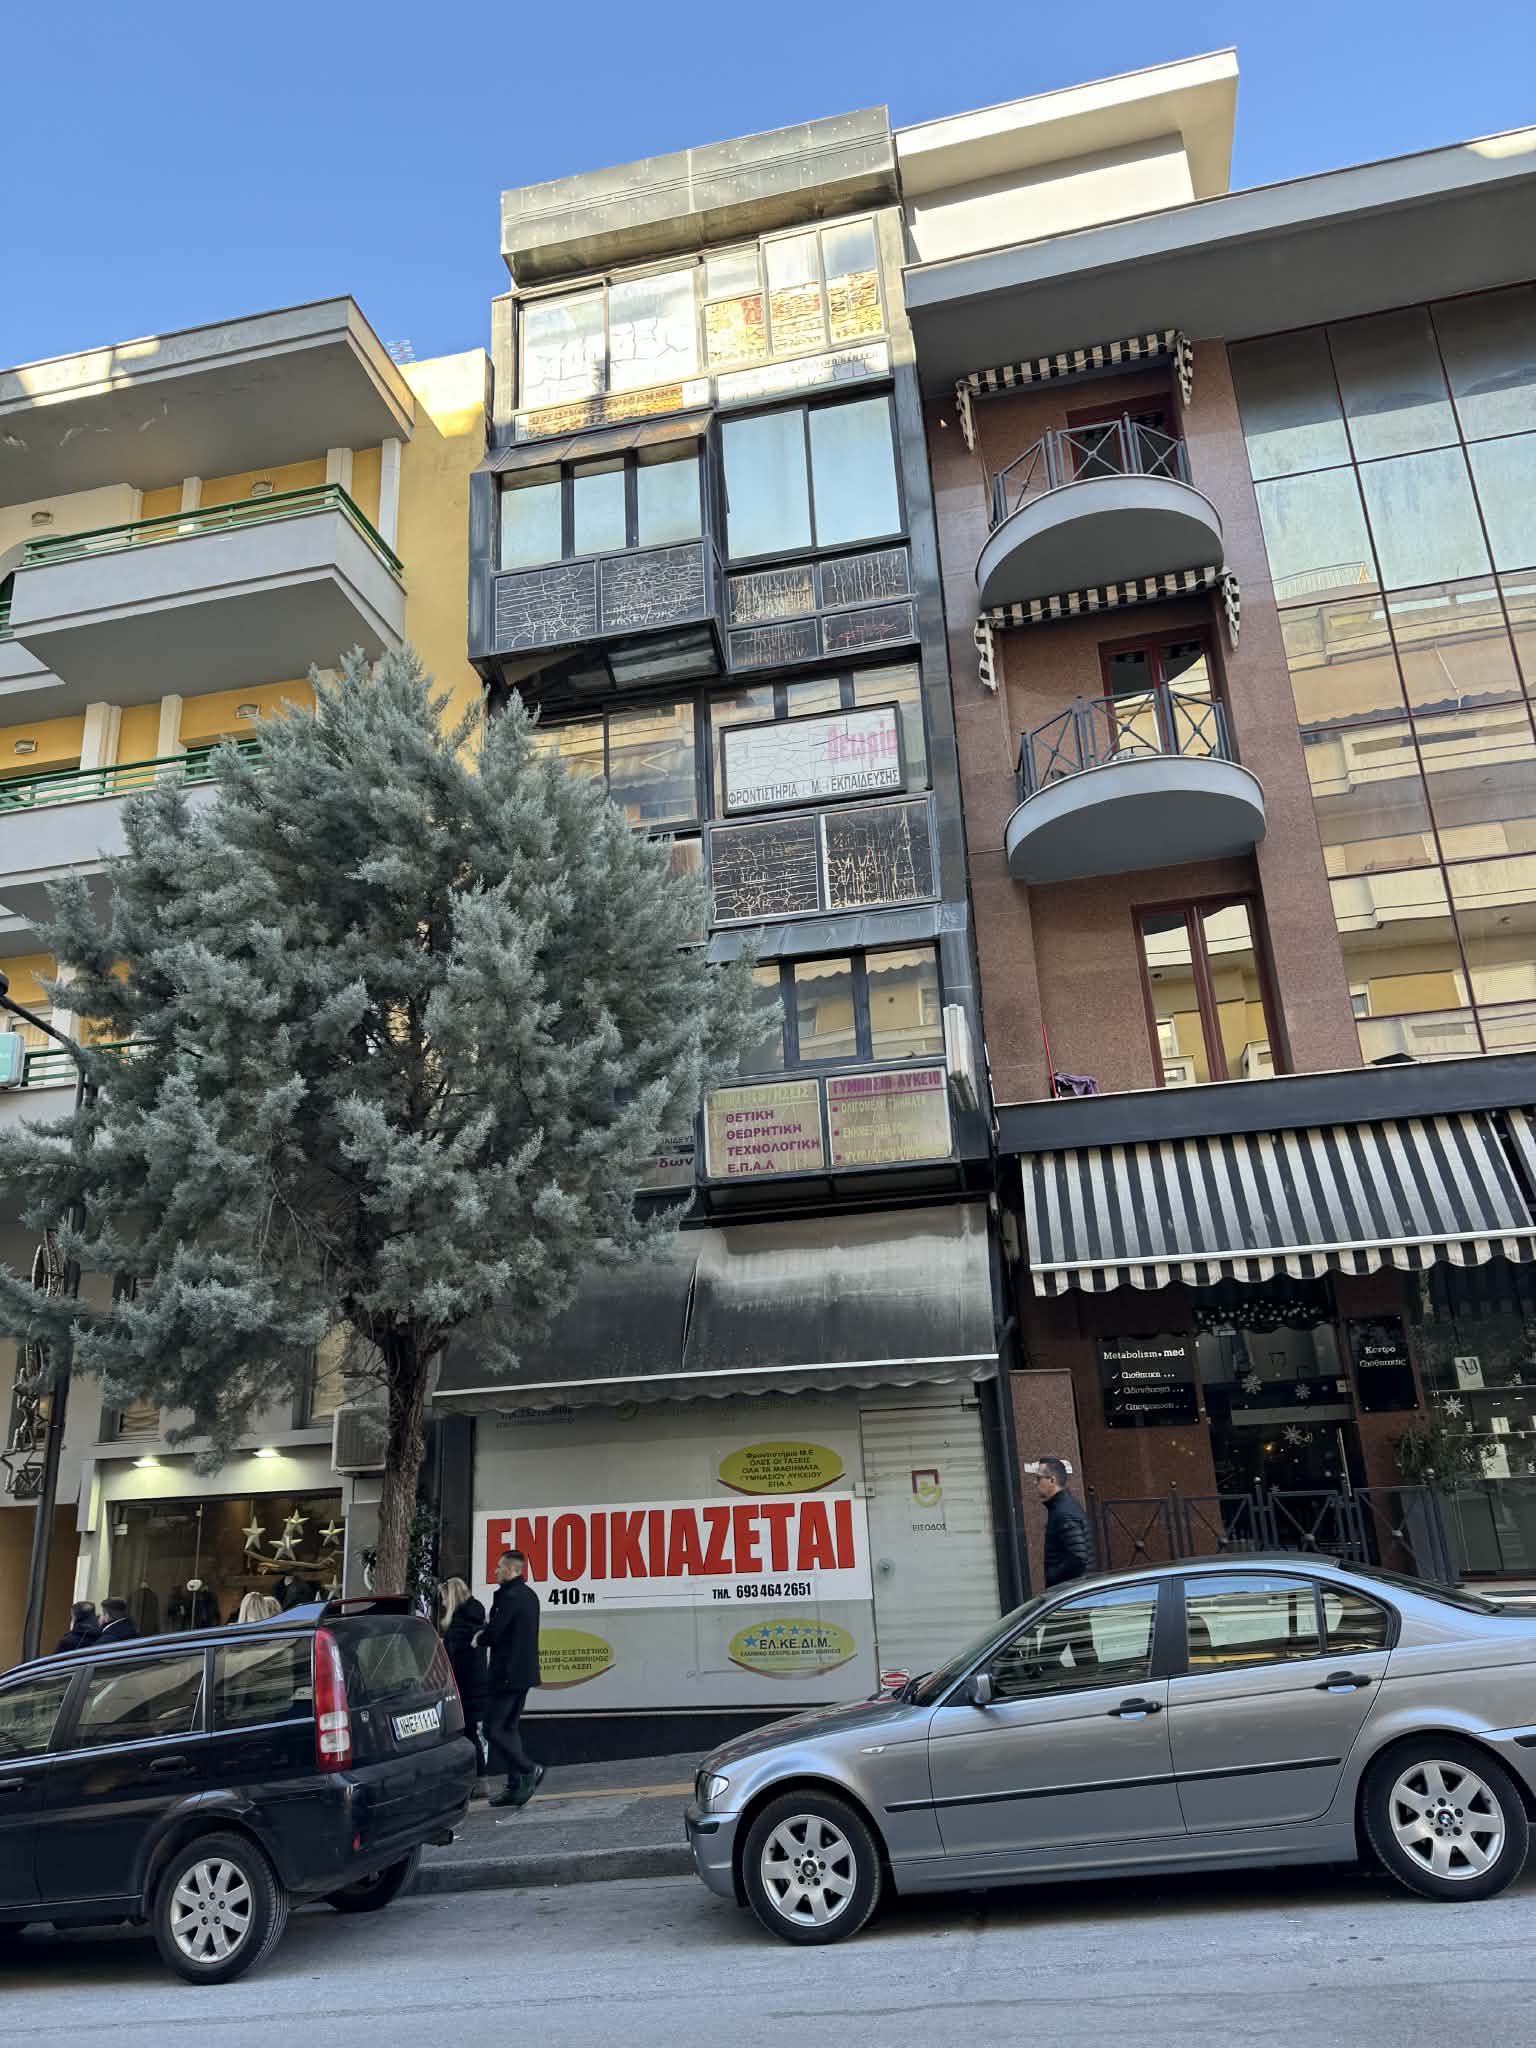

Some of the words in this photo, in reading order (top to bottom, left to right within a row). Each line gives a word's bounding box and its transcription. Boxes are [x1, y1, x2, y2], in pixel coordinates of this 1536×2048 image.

[728, 783, 798, 805] ΦΡΟΝΤΙΣΤΗΡΙΑ
[831, 769, 899, 792] ΕΚΠΑΙΔΕΥΣΗΣ
[726, 1110, 774, 1123] ΘΕΤΙΚΗ
[726, 1124, 802, 1140] ΘΕΩΡΗΤΙΚΗ
[727, 1139, 820, 1157] ΤΕΧΝΟΛΟΓΙΚΗ
[773, 1464, 819, 1472] ΜΑΘΗΜΑΤΑ
[788, 1471, 822, 1479] ΛΥΚΕΙΟΥ
[912, 1523, 947, 1532] ΕΙΣΟΔΟΣ
[486, 1500, 855, 1585] ΕΝΟΙΚΙΑΖΕΤΑΙ
[548, 1587, 580, 1606] 410
